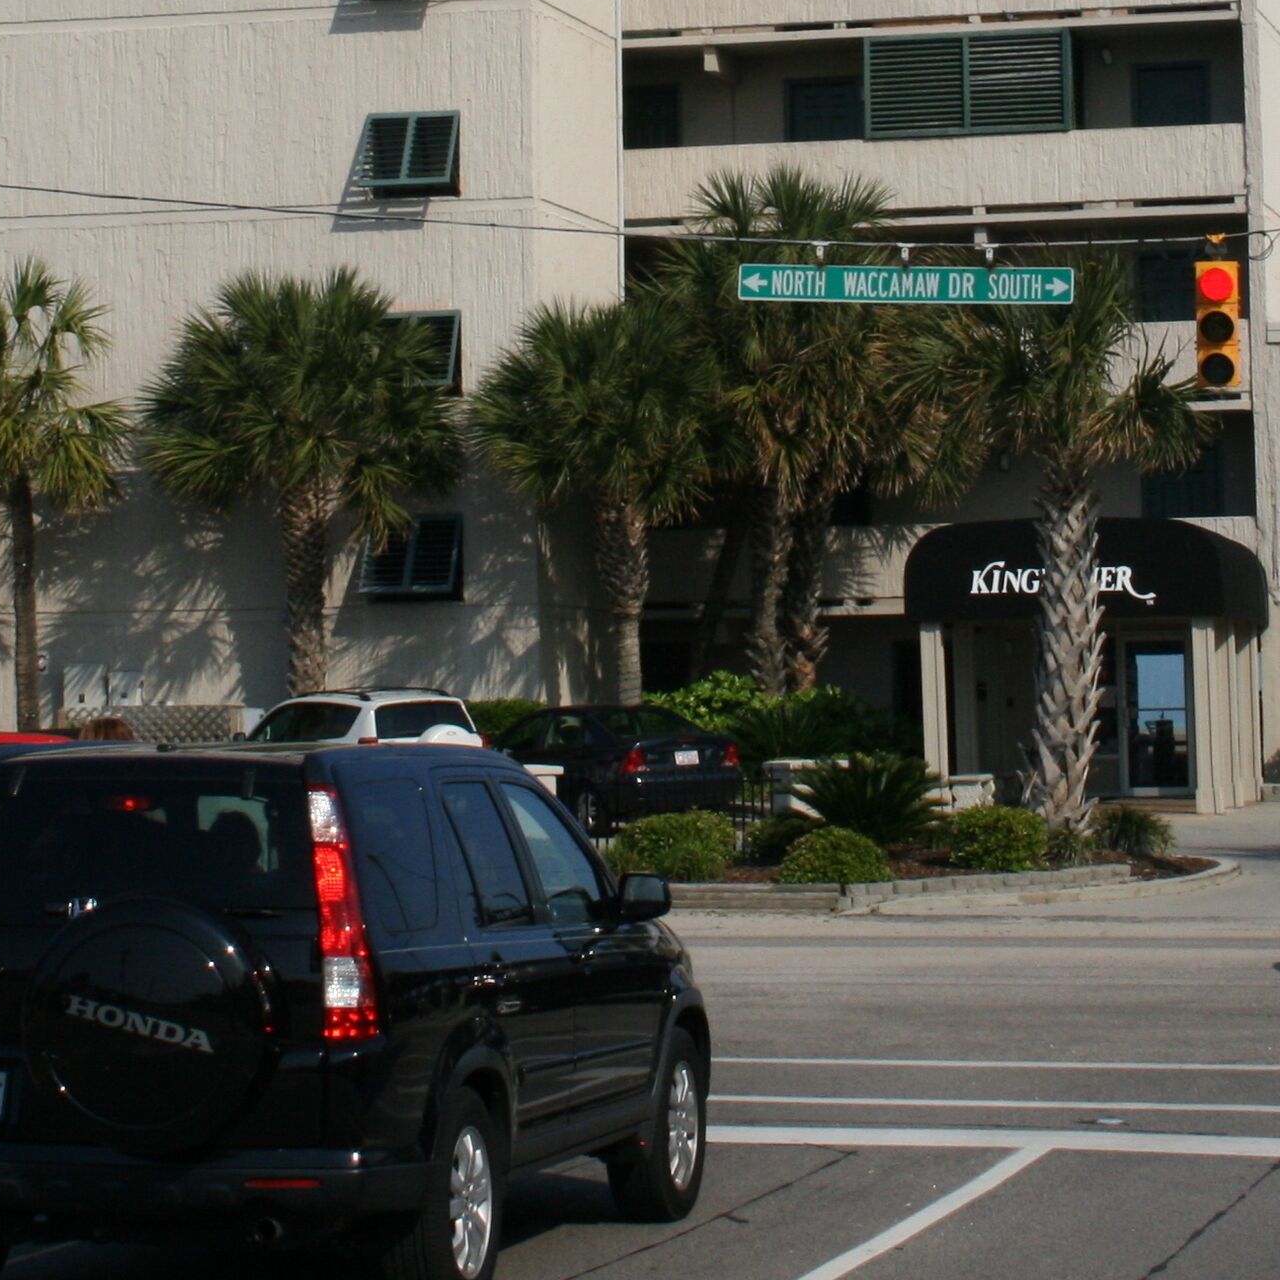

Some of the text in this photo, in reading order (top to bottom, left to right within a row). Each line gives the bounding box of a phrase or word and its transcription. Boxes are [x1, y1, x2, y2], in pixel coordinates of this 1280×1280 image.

[771, 270, 1042, 299] NORTH WACCAMAW DR SOUTH
[970, 560, 1157, 600] KINGER
[65, 994, 214, 1054] HONDA
